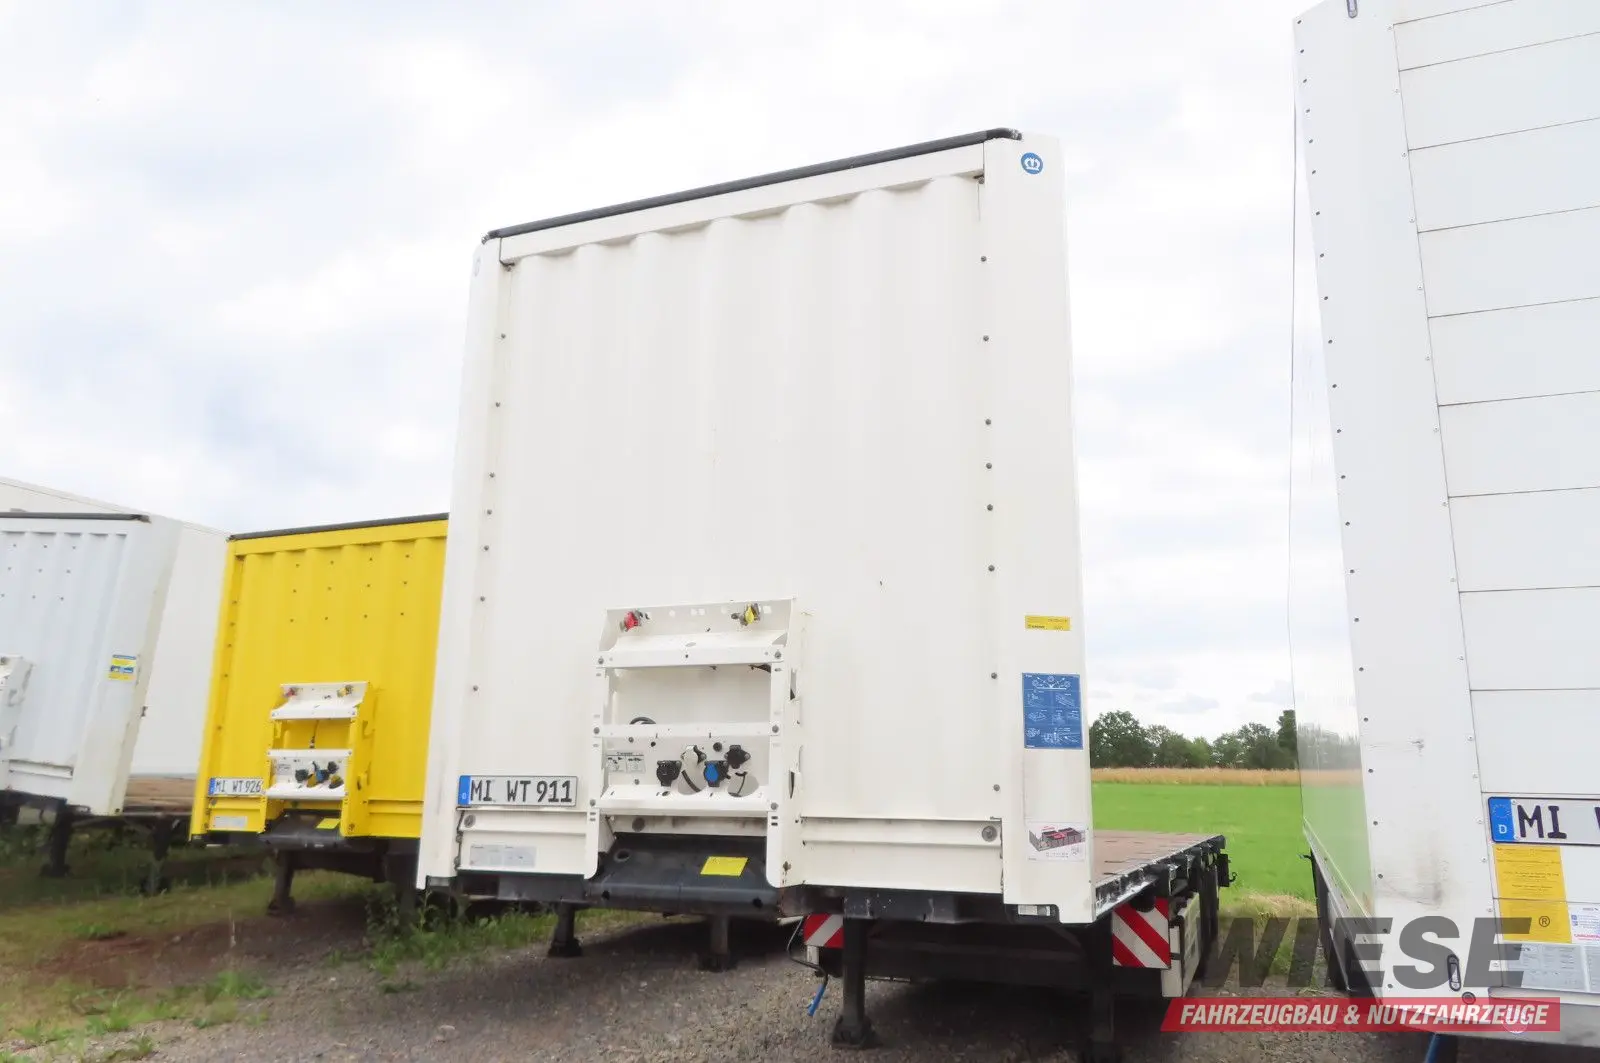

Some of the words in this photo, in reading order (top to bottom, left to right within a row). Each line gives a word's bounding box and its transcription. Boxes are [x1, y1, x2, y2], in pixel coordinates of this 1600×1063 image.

[215, 780, 226, 793] MI
[232, 780, 244, 793] WT
[245, 780, 262, 793] 926
[471, 780, 492, 802] MI
[507, 780, 531, 803] WT
[536, 780, 572, 803] 911
[1498, 824, 1508, 834] D
[1517, 804, 1567, 839] MI
